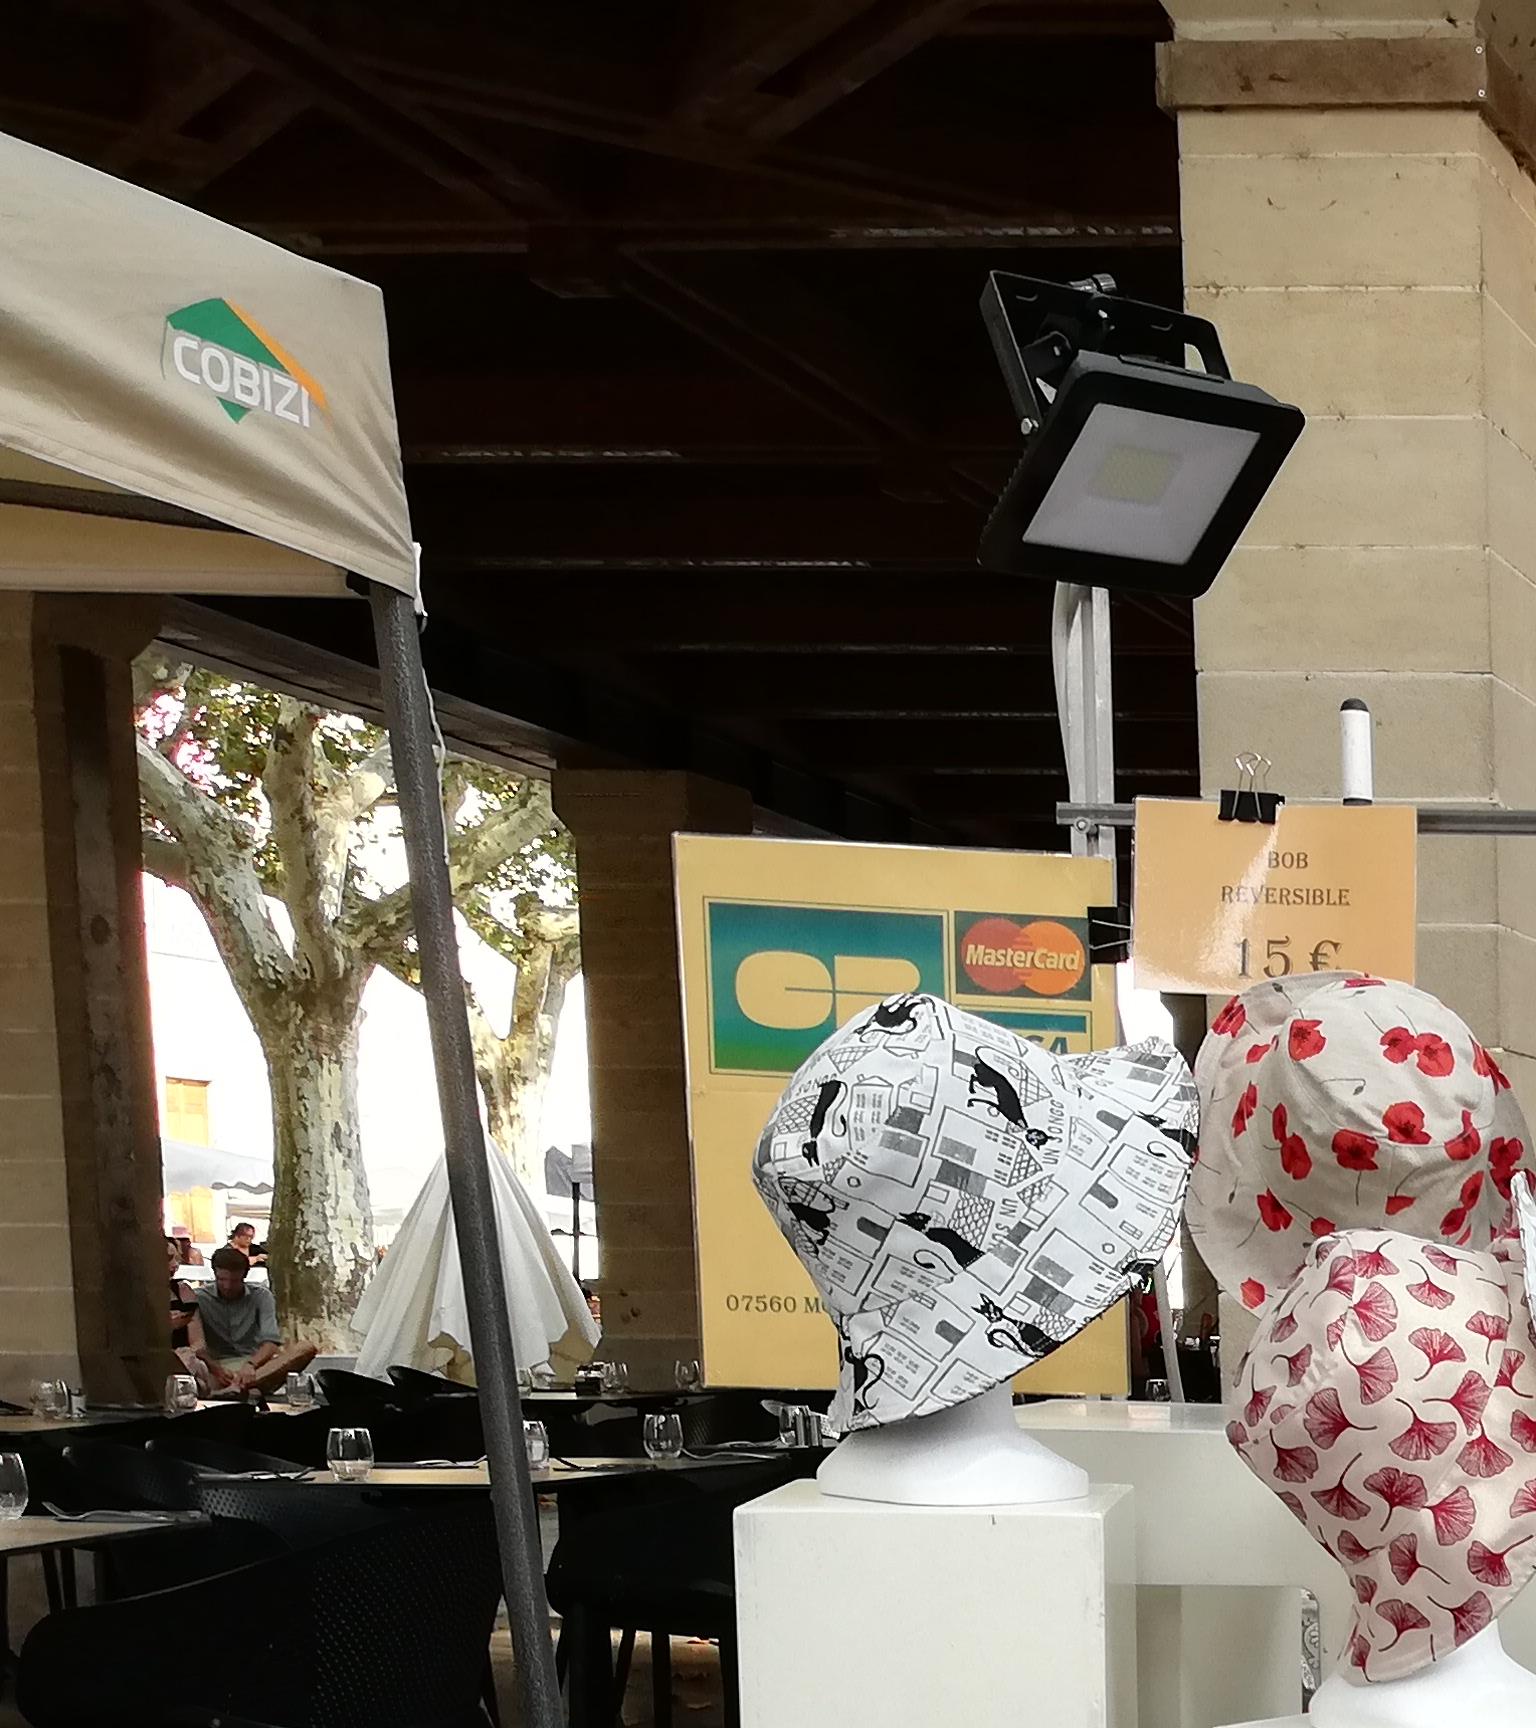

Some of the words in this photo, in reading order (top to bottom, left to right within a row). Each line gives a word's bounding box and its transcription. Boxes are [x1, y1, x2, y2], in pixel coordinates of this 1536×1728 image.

[173, 336, 311, 428] COBIZI
[1266, 851, 1309, 869] BOB
[1220, 884, 1352, 906] REVERSIBLE
[965, 944, 1081, 973] MasterCard
[1231, 935, 1294, 979] 15
[1308, 938, 1344, 973] €
[725, 1294, 798, 1313] 07560
